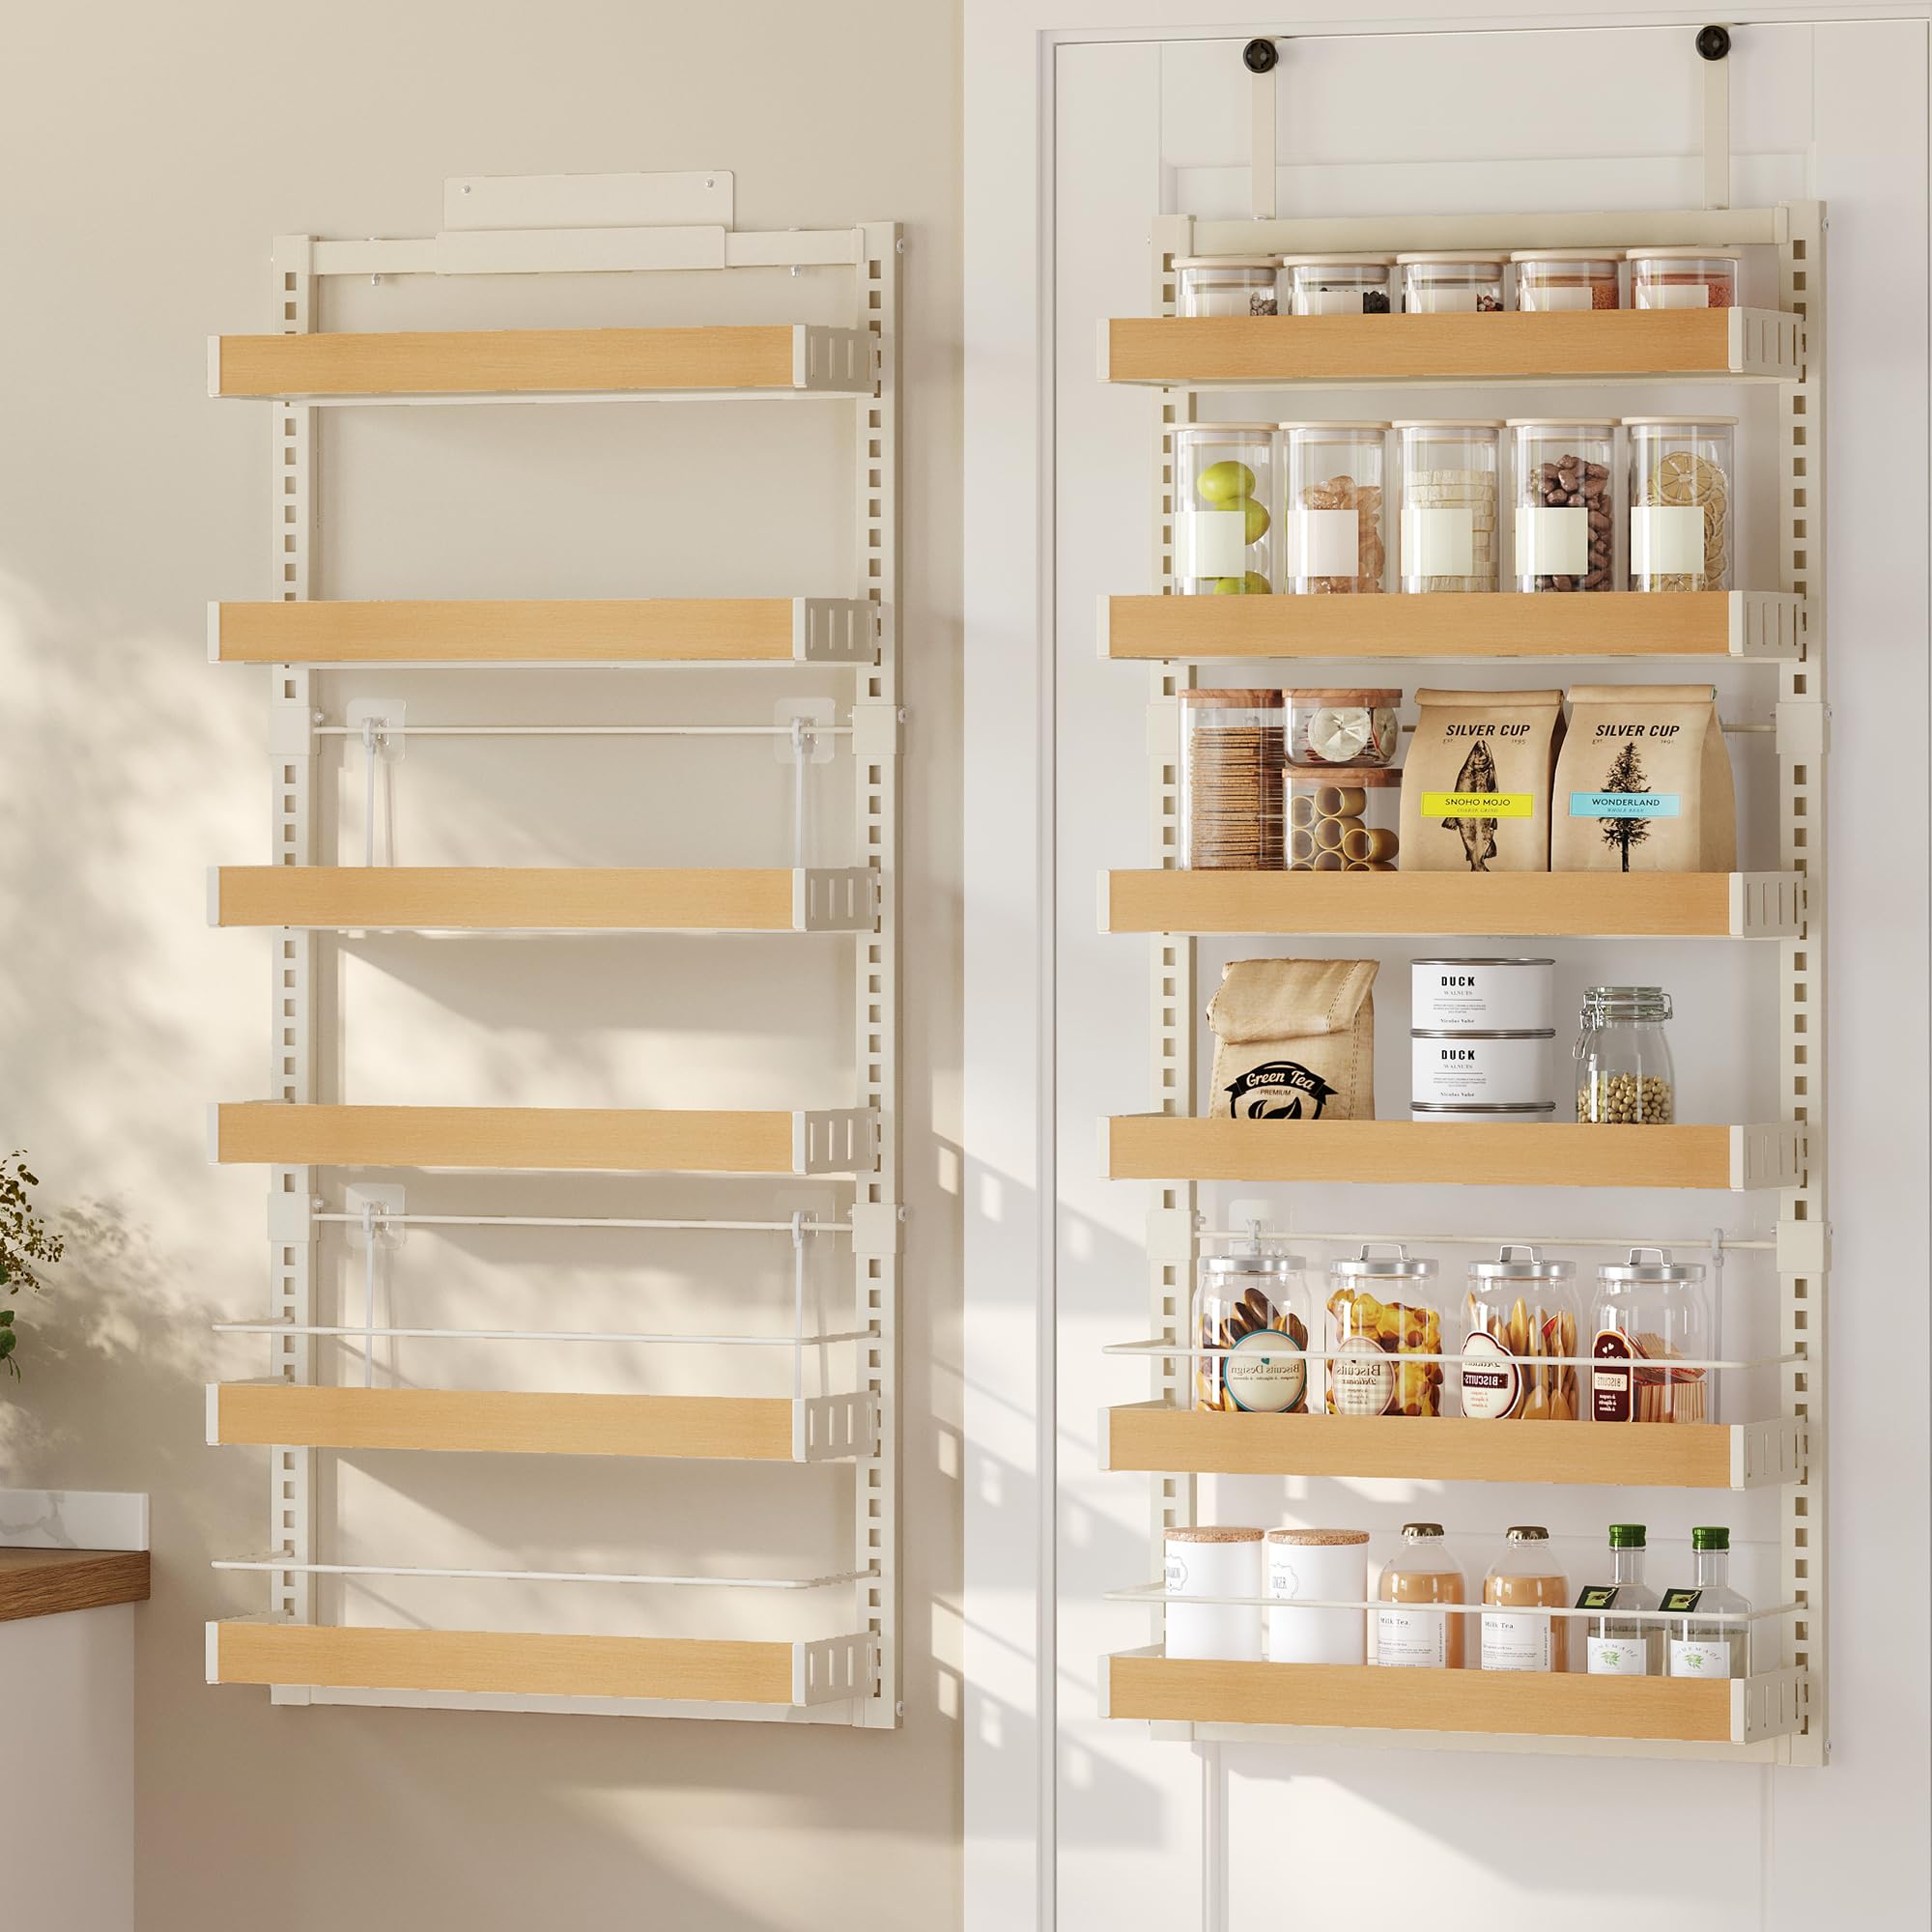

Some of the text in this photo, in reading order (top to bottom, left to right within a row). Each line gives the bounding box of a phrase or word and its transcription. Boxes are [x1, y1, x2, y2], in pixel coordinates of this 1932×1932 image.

[1446, 724, 1531, 736] SILVER CUP
[1595, 724, 1680, 737] SILVER CUP
[1444, 798, 1511, 807] SNOHO MOJO
[1591, 798, 1661, 807] WONDERLAND
[1441, 976, 1475, 986] DUCK
[1441, 1050, 1475, 1061] DUCK
[1246, 1070, 1316, 1091] Green Tea
